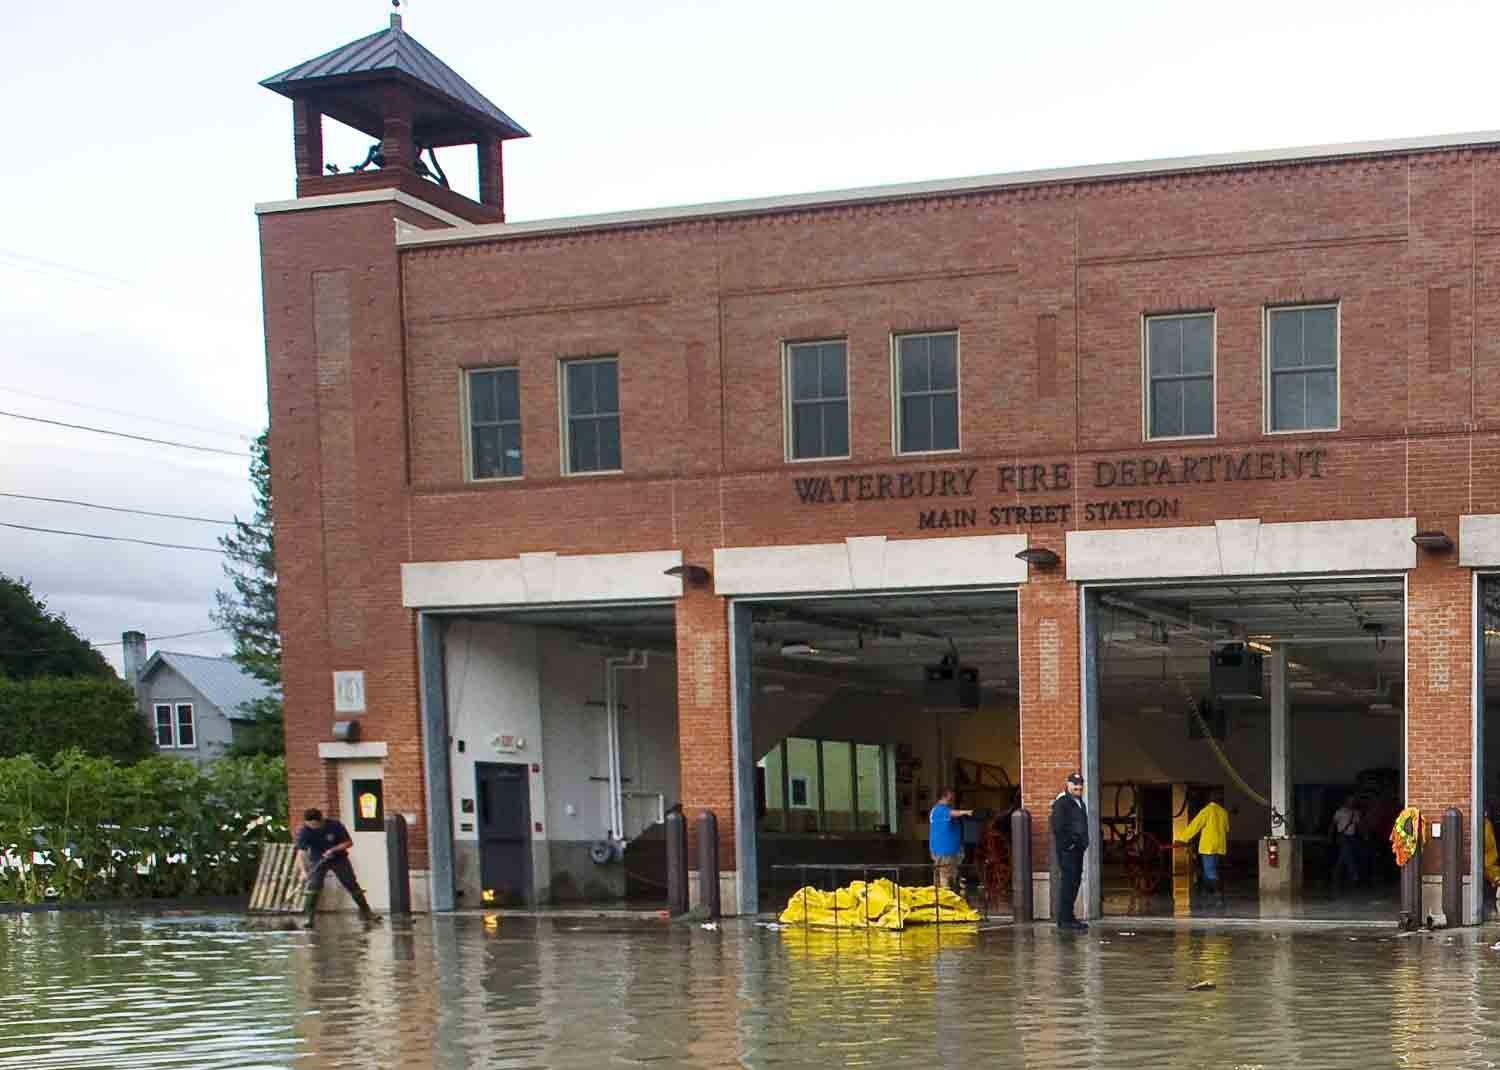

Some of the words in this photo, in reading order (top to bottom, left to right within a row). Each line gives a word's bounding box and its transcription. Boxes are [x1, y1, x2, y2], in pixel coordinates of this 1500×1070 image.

[794, 468, 977, 504] WATERBURY
[997, 463, 1072, 493] FIRE
[1093, 448, 1327, 489] DEPARTMENT
[919, 508, 976, 530] MAIN
[989, 503, 1072, 527] STREET
[1084, 497, 1179, 522] STATION
